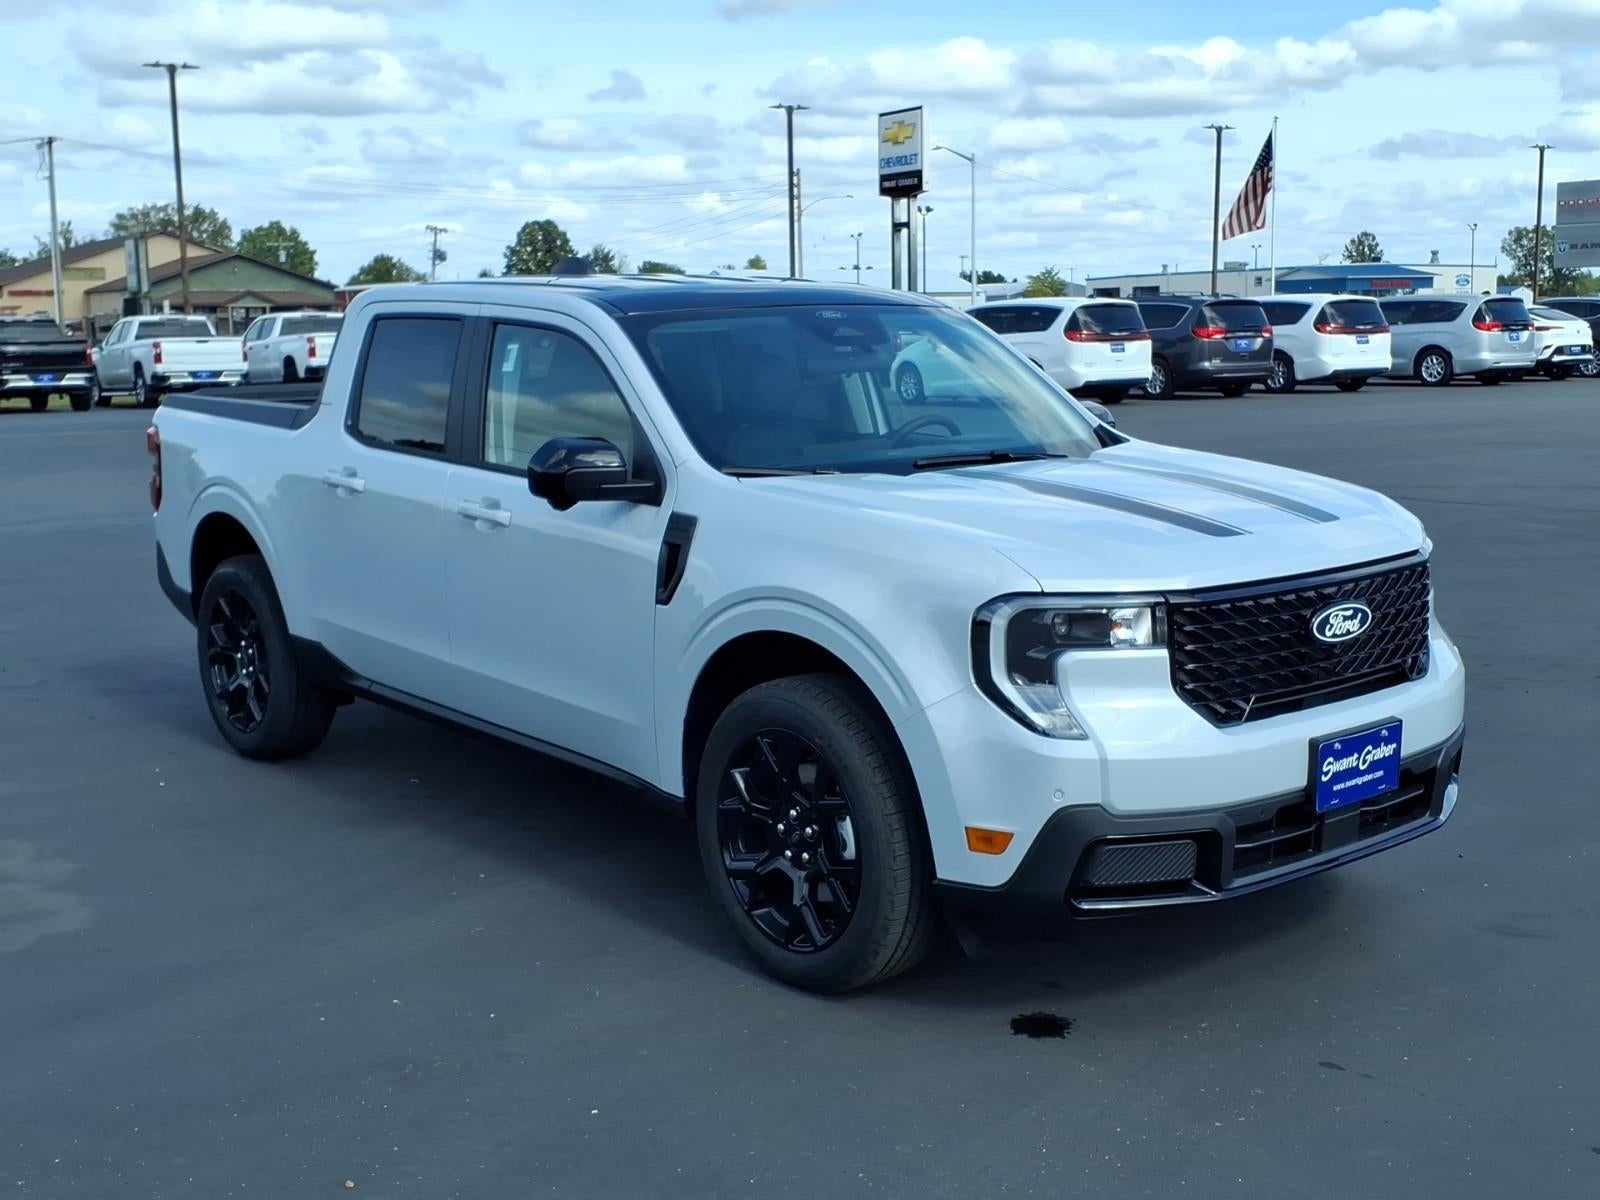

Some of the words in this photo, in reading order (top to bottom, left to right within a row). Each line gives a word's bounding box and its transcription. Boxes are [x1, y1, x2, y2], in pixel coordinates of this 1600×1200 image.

[880, 153, 917, 168] CHEVROLET
[1325, 609, 1362, 637] Ford
[1321, 752, 1359, 782] Swant
[1359, 742, 1397, 770] Graber
[1333, 770, 1384, 791] www.swantgraber.com
